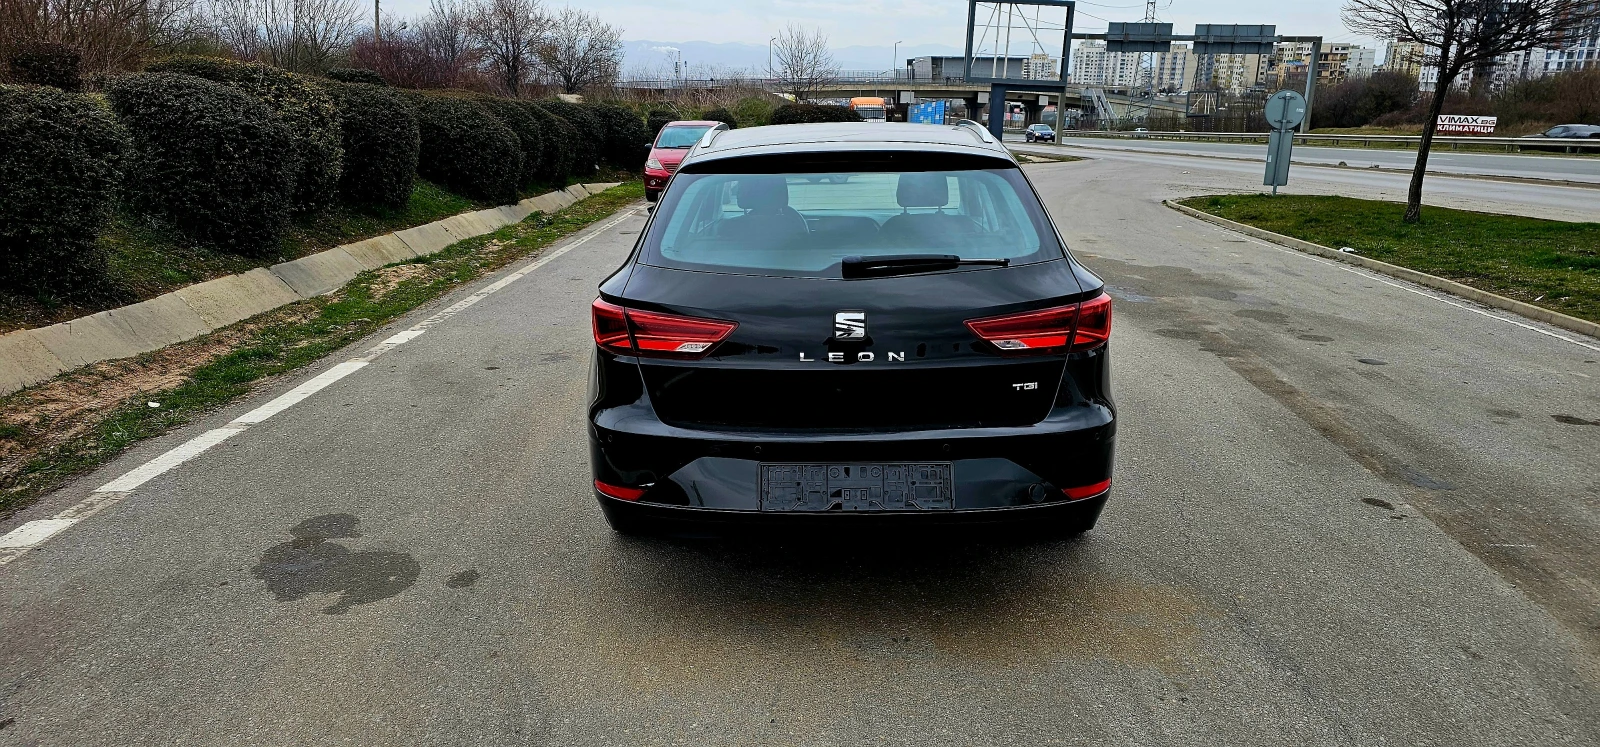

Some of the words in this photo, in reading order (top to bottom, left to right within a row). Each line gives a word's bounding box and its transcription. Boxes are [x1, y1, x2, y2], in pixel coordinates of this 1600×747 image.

[1437, 125, 1494, 133] КЛИМАТИЦИ
[799, 351, 905, 362] LEON
[1012, 381, 1038, 391] TGI
